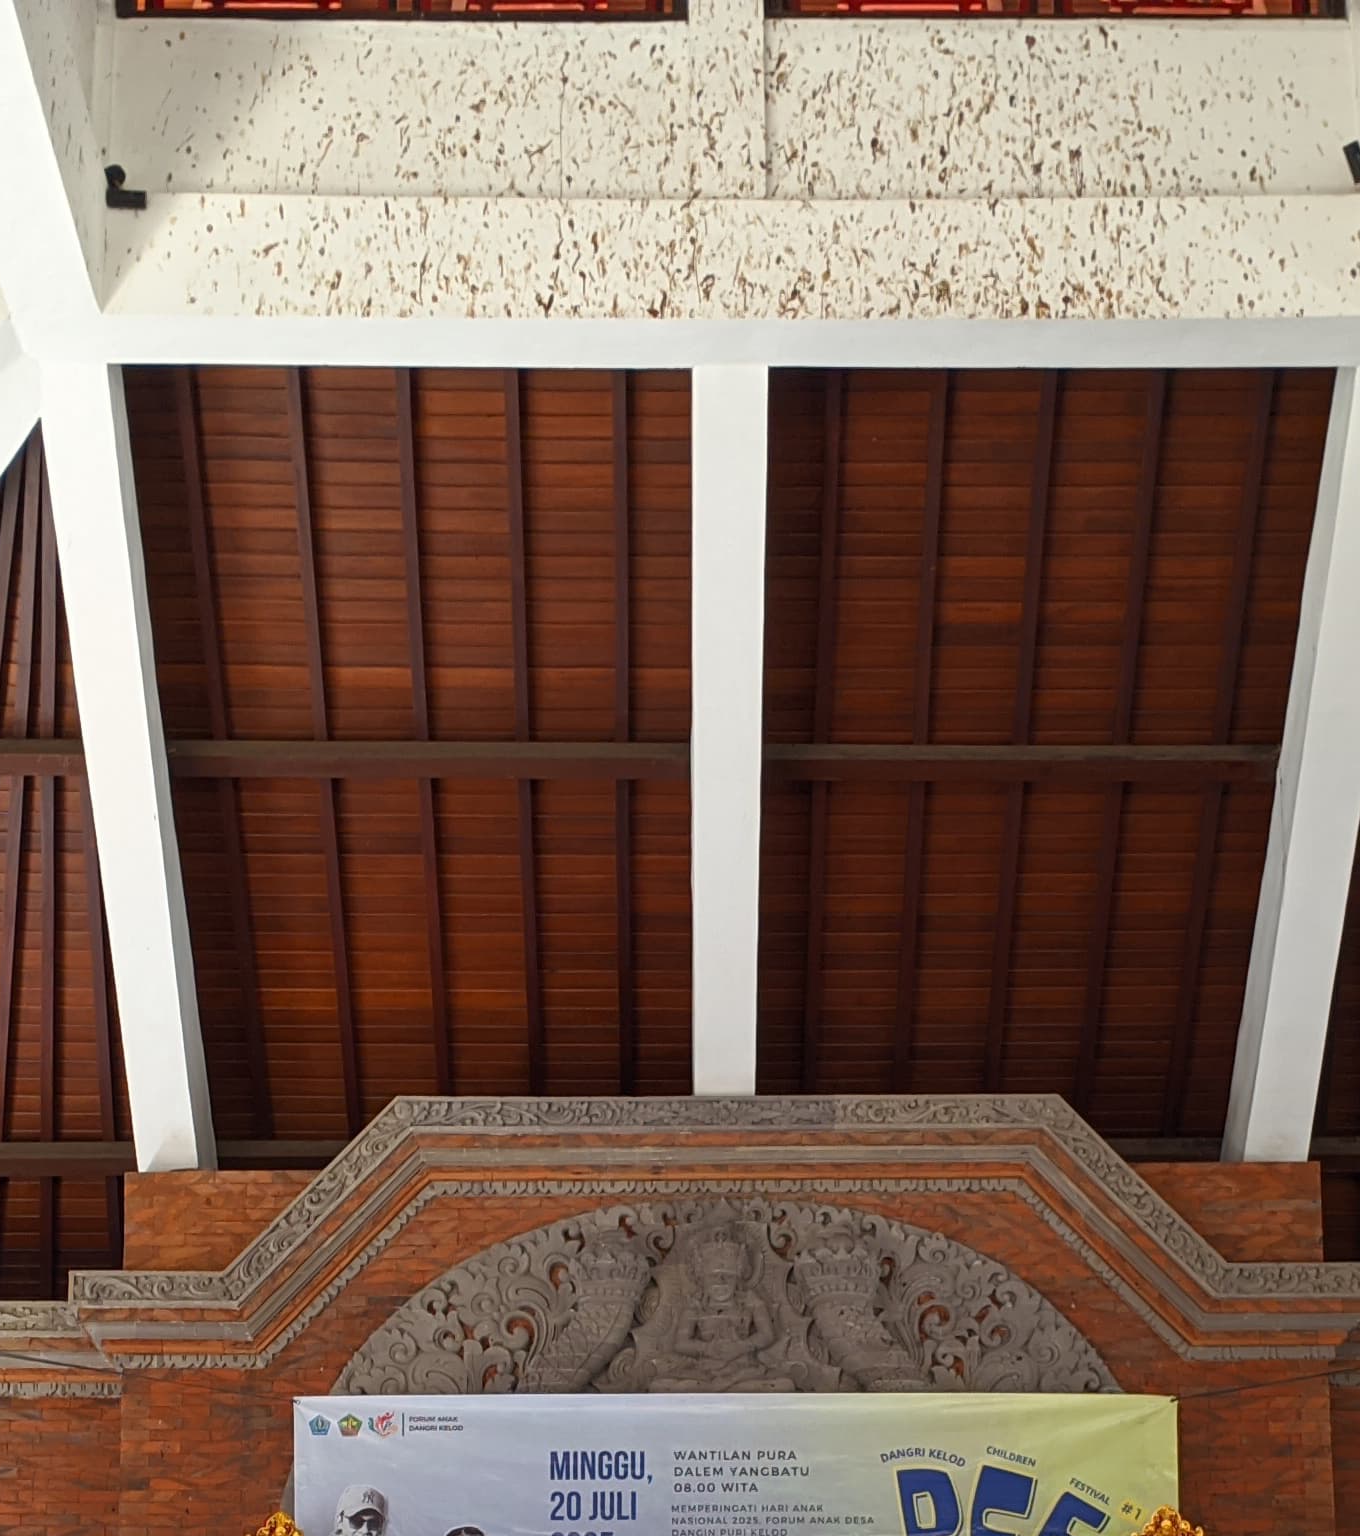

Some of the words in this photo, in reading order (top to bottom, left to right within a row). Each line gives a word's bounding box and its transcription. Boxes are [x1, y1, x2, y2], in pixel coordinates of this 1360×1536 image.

[673, 1450, 752, 1461] WANTILAN
[757, 1450, 798, 1461] PURA
[880, 1448, 926, 1463] DANGRI
[929, 1448, 966, 1467] KELOD
[986, 1446, 1037, 1467] CHILDREN
[549, 1451, 653, 1485] MINGGU,
[673, 1466, 724, 1477] DALEM
[729, 1466, 810, 1477] YANGBATU
[673, 1482, 716, 1493] 08.00
[721, 1482, 759, 1493] WITA
[1069, 1477, 1110, 1506] FESTIVAL
[549, 1492, 582, 1521] 20
[588, 1491, 638, 1521] JULI
[671, 1504, 757, 1513] MEMPERINGATI
[761, 1504, 789, 1513] HARI
[792, 1504, 823, 1512] ANAK
[671, 1516, 728, 1525] NASIONAL
[766, 1516, 805, 1525] FORUM
[809, 1516, 840, 1525] ANAK
[844, 1516, 875, 1525] DESA
[671, 1529, 715, 1536] DANGIN
[720, 1528, 747, 1536] PURI
[751, 1528, 788, 1536] KELOD
